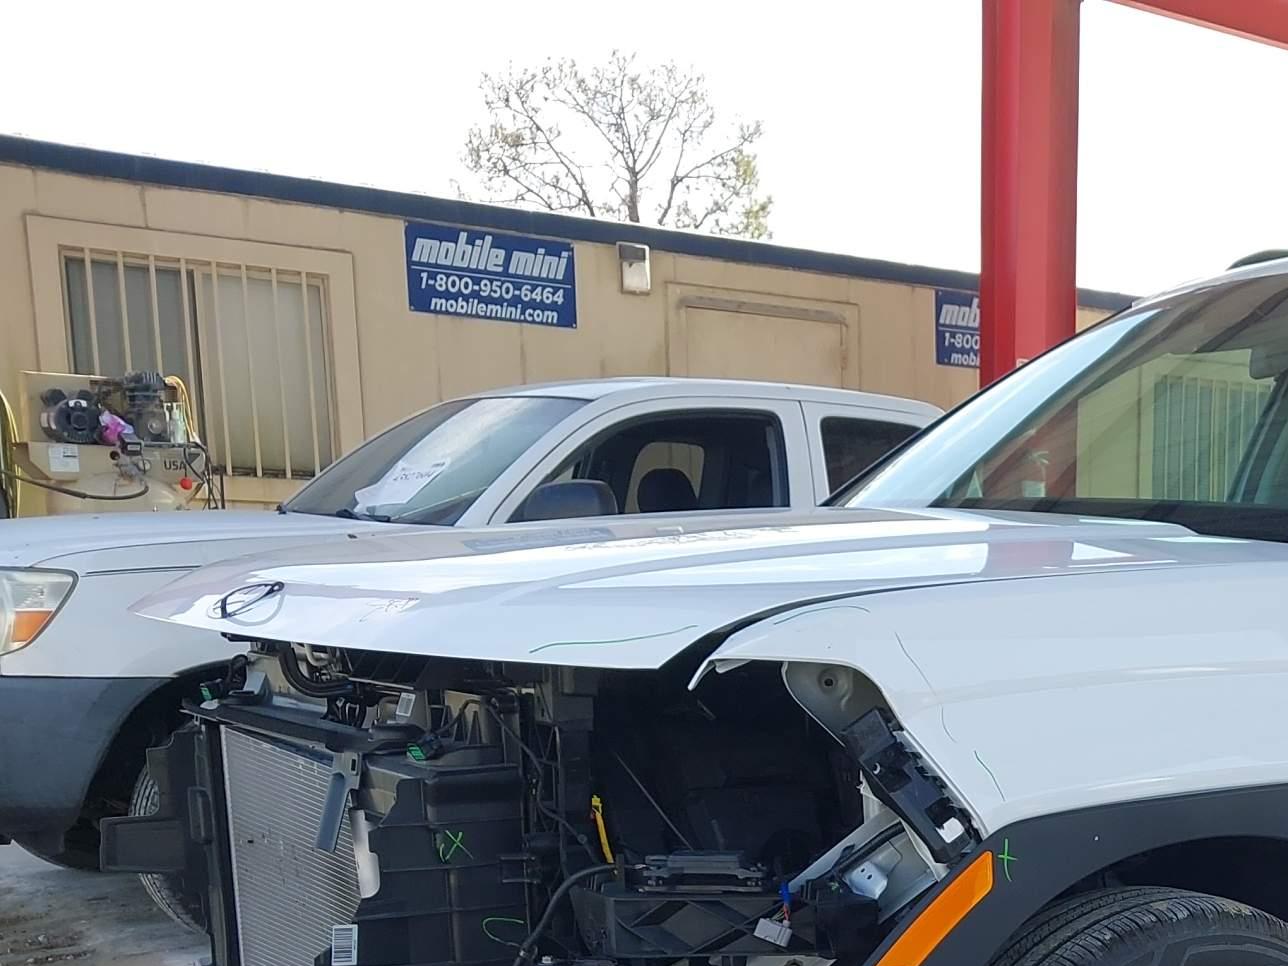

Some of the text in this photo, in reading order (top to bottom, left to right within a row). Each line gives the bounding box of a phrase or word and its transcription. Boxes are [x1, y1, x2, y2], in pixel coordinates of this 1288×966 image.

[411, 232, 569, 280] mobile mini
[420, 271, 564, 305] 1-800-950-6464
[430, 297, 558, 324] mobilemini.com
[164, 459, 187, 471] USA
